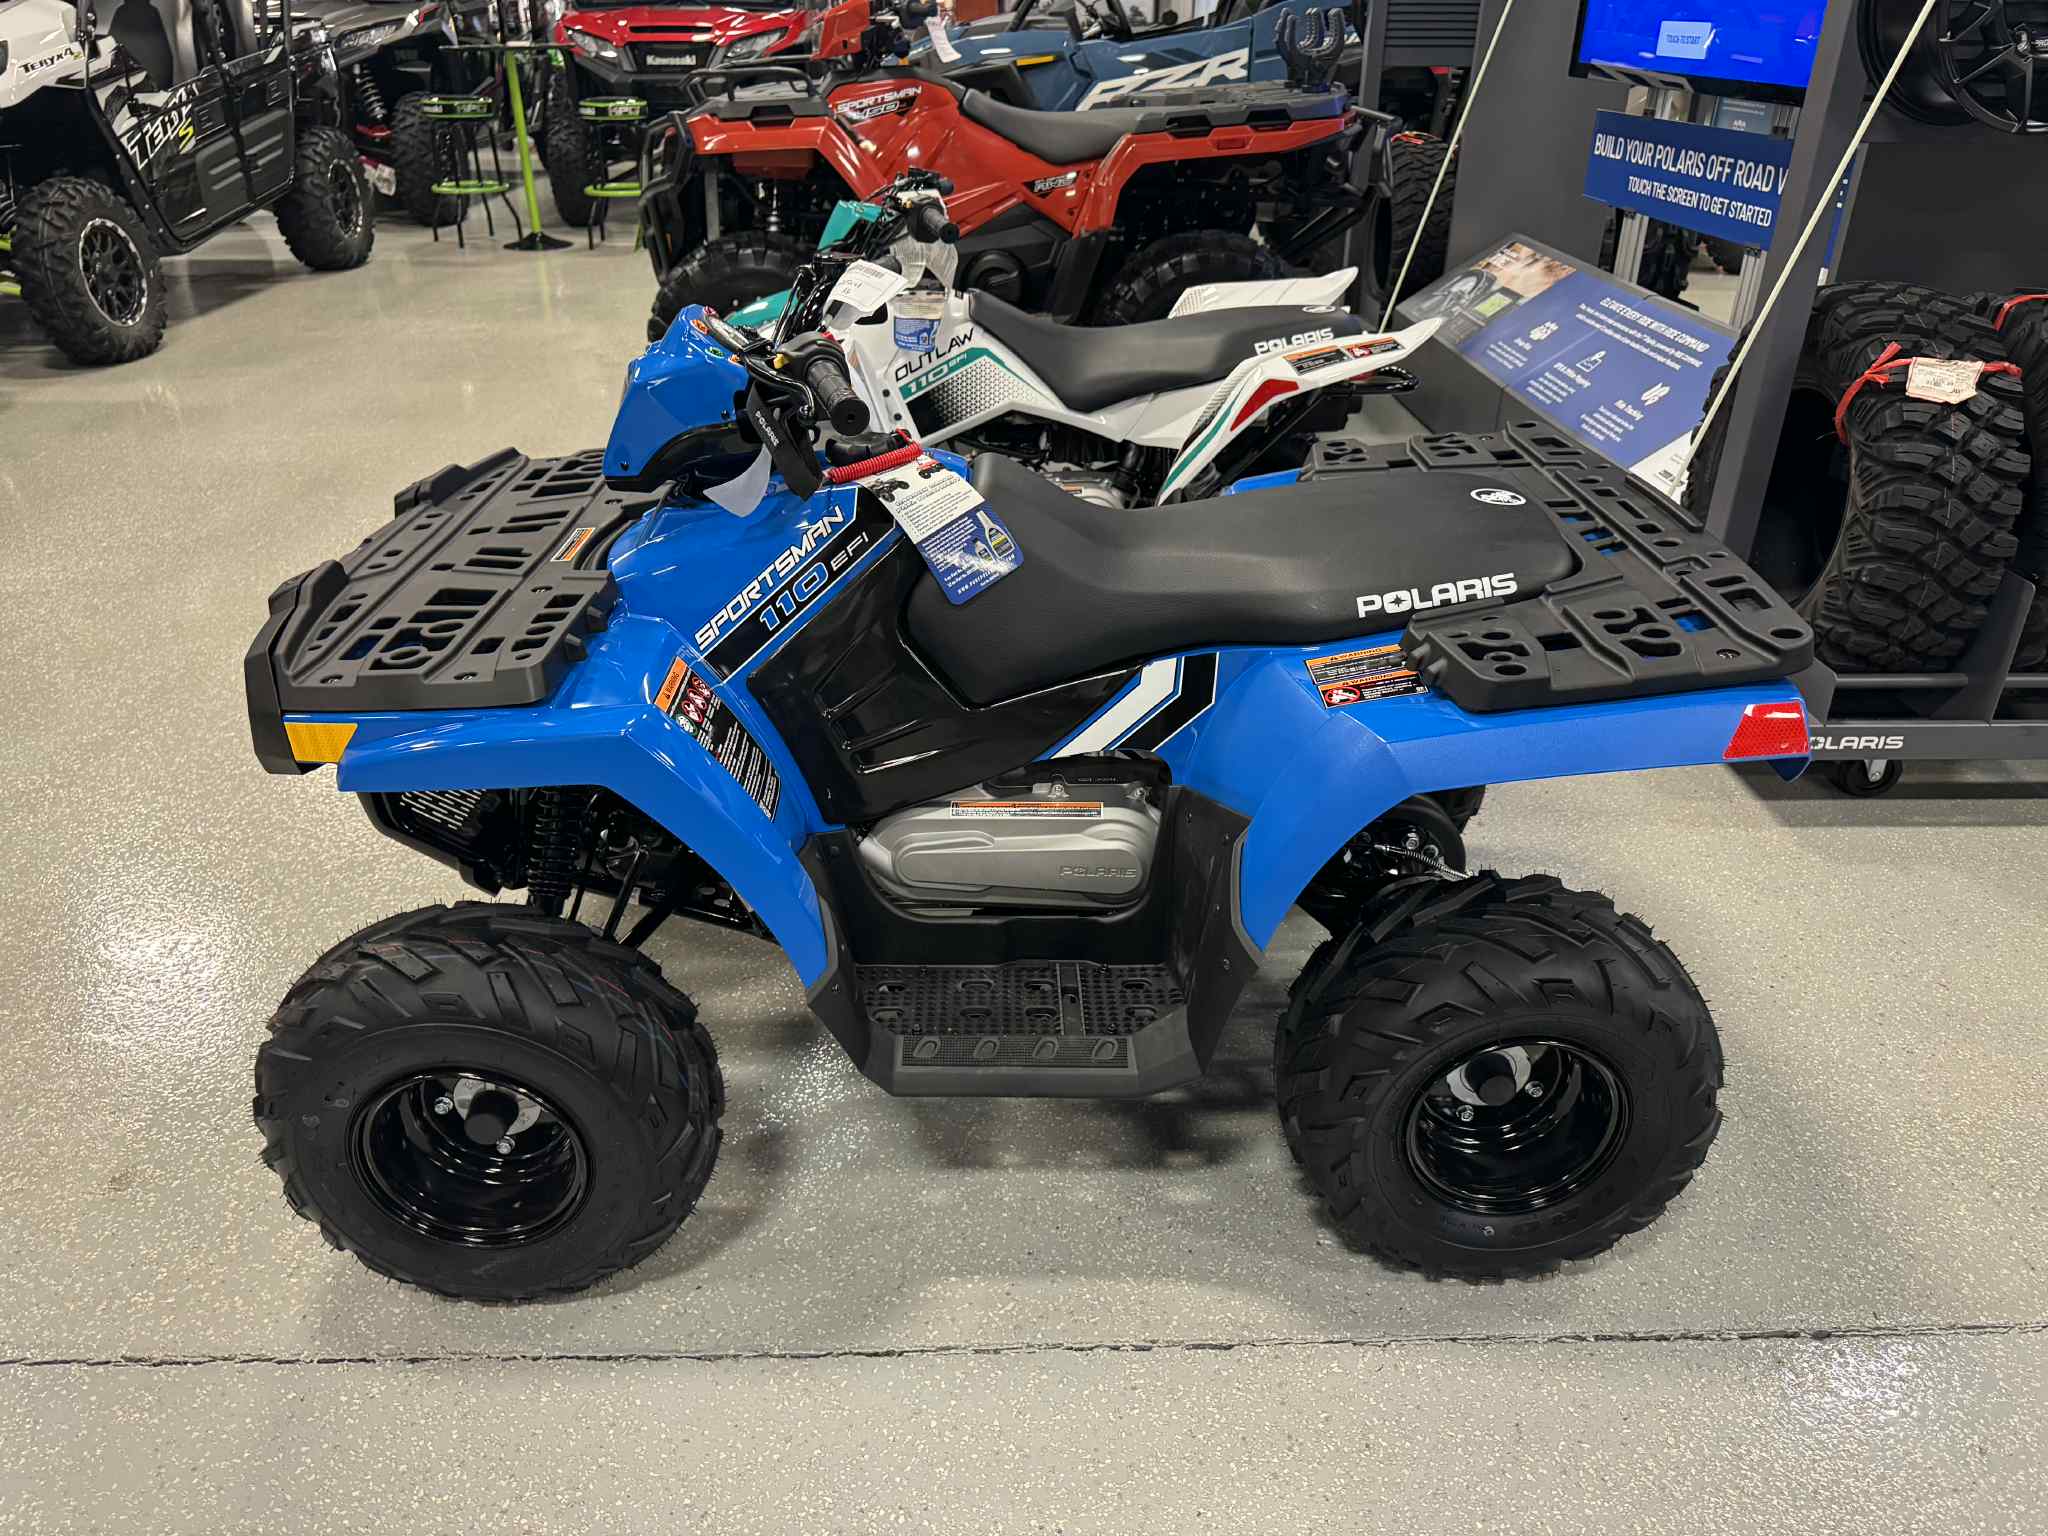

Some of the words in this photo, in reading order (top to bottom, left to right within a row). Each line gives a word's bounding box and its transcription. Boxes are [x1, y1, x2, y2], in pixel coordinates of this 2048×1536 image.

[646, 54, 697, 66] Kawasaki
[1075, 48, 1249, 111] RZR
[836, 86, 922, 113] SPORTSMAN
[1594, 134, 1624, 160] BUILD
[1625, 138, 1653, 167] YOUR
[1654, 144, 1704, 178] POLARIS
[1706, 154, 1734, 183] OFF
[1733, 161, 1775, 192] ROAD
[1628, 176, 1652, 195] TOUCH
[1652, 182, 1668, 200] THE
[1667, 186, 1698, 208] SCREEN
[1698, 193, 1711, 212] TO
[1711, 196, 1729, 216] GET
[1729, 200, 1772, 227] STARTED
[895, 328, 974, 382] OUTLAW
[1254, 328, 1334, 355] POLARIS
[907, 363, 949, 393] 110
[694, 505, 845, 651] SPORTSMAN
[760, 562, 829, 632] 110
[831, 531, 869, 571] EFI
[1356, 572, 1518, 618] POLARIS
[1809, 735, 1905, 750] OLARIS
[1058, 865, 1137, 879] POLARIS
